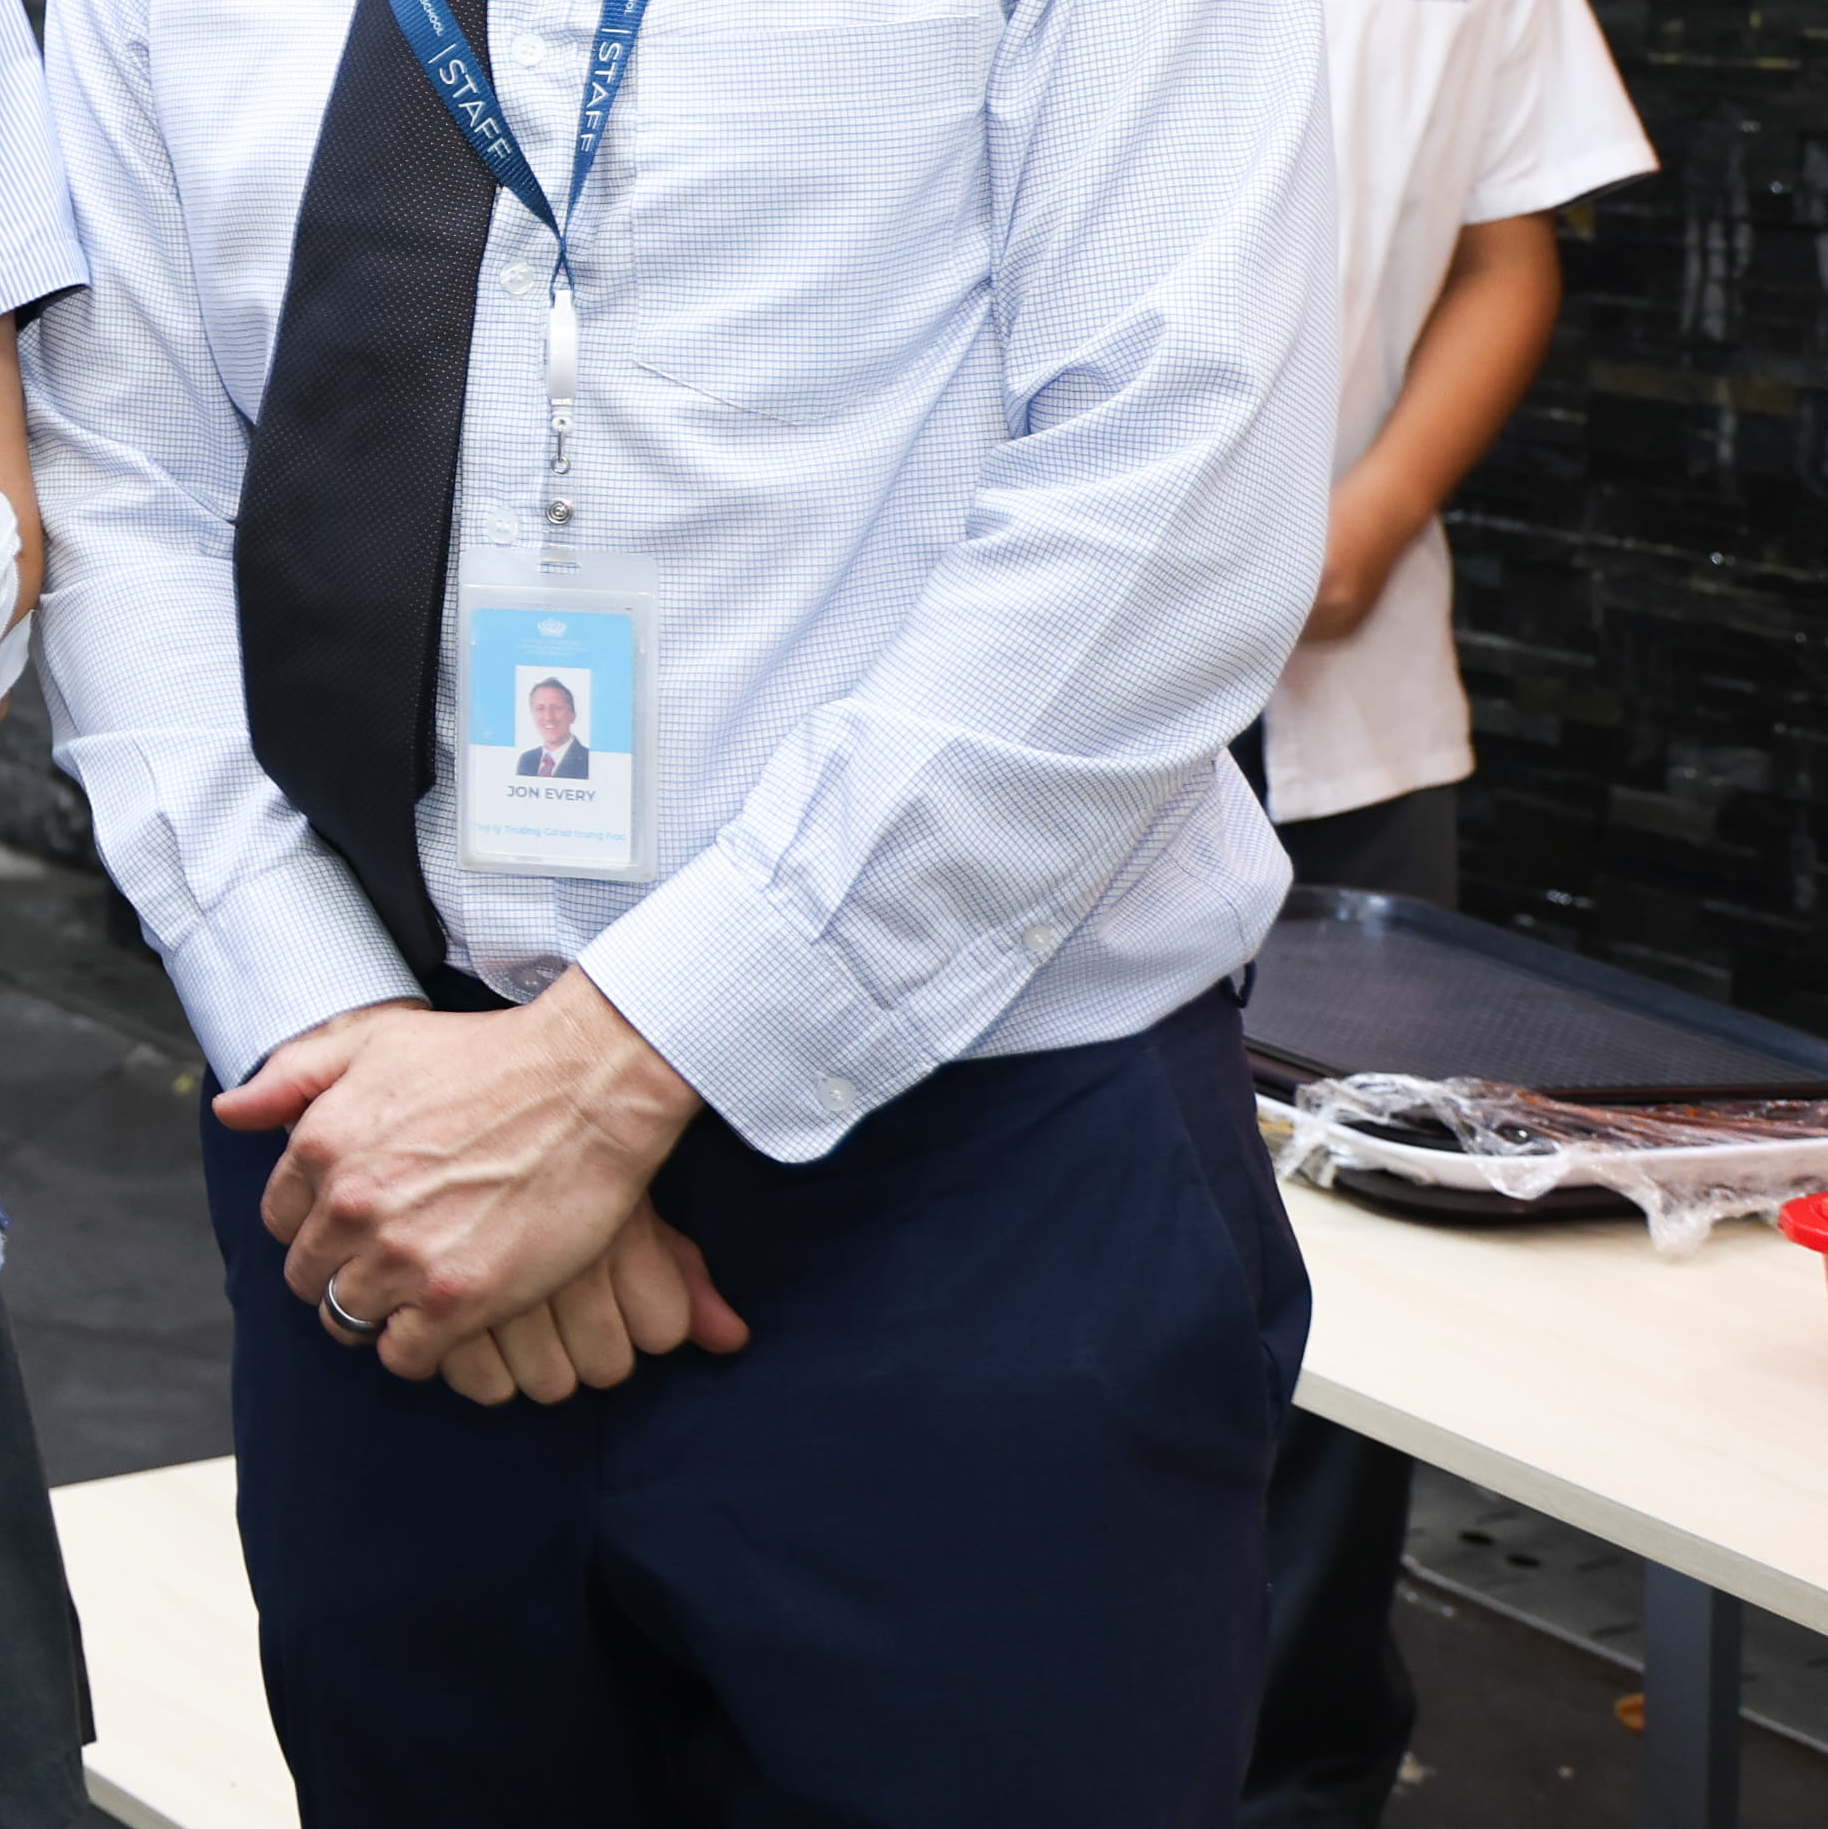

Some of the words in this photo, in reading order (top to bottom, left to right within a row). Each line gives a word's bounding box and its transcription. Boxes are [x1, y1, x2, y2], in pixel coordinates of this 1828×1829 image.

[439, 60, 513, 158] STAFF
[581, 42, 622, 152] STAFF
[507, 785, 540, 799] JON
[545, 788, 596, 802] EVERY
